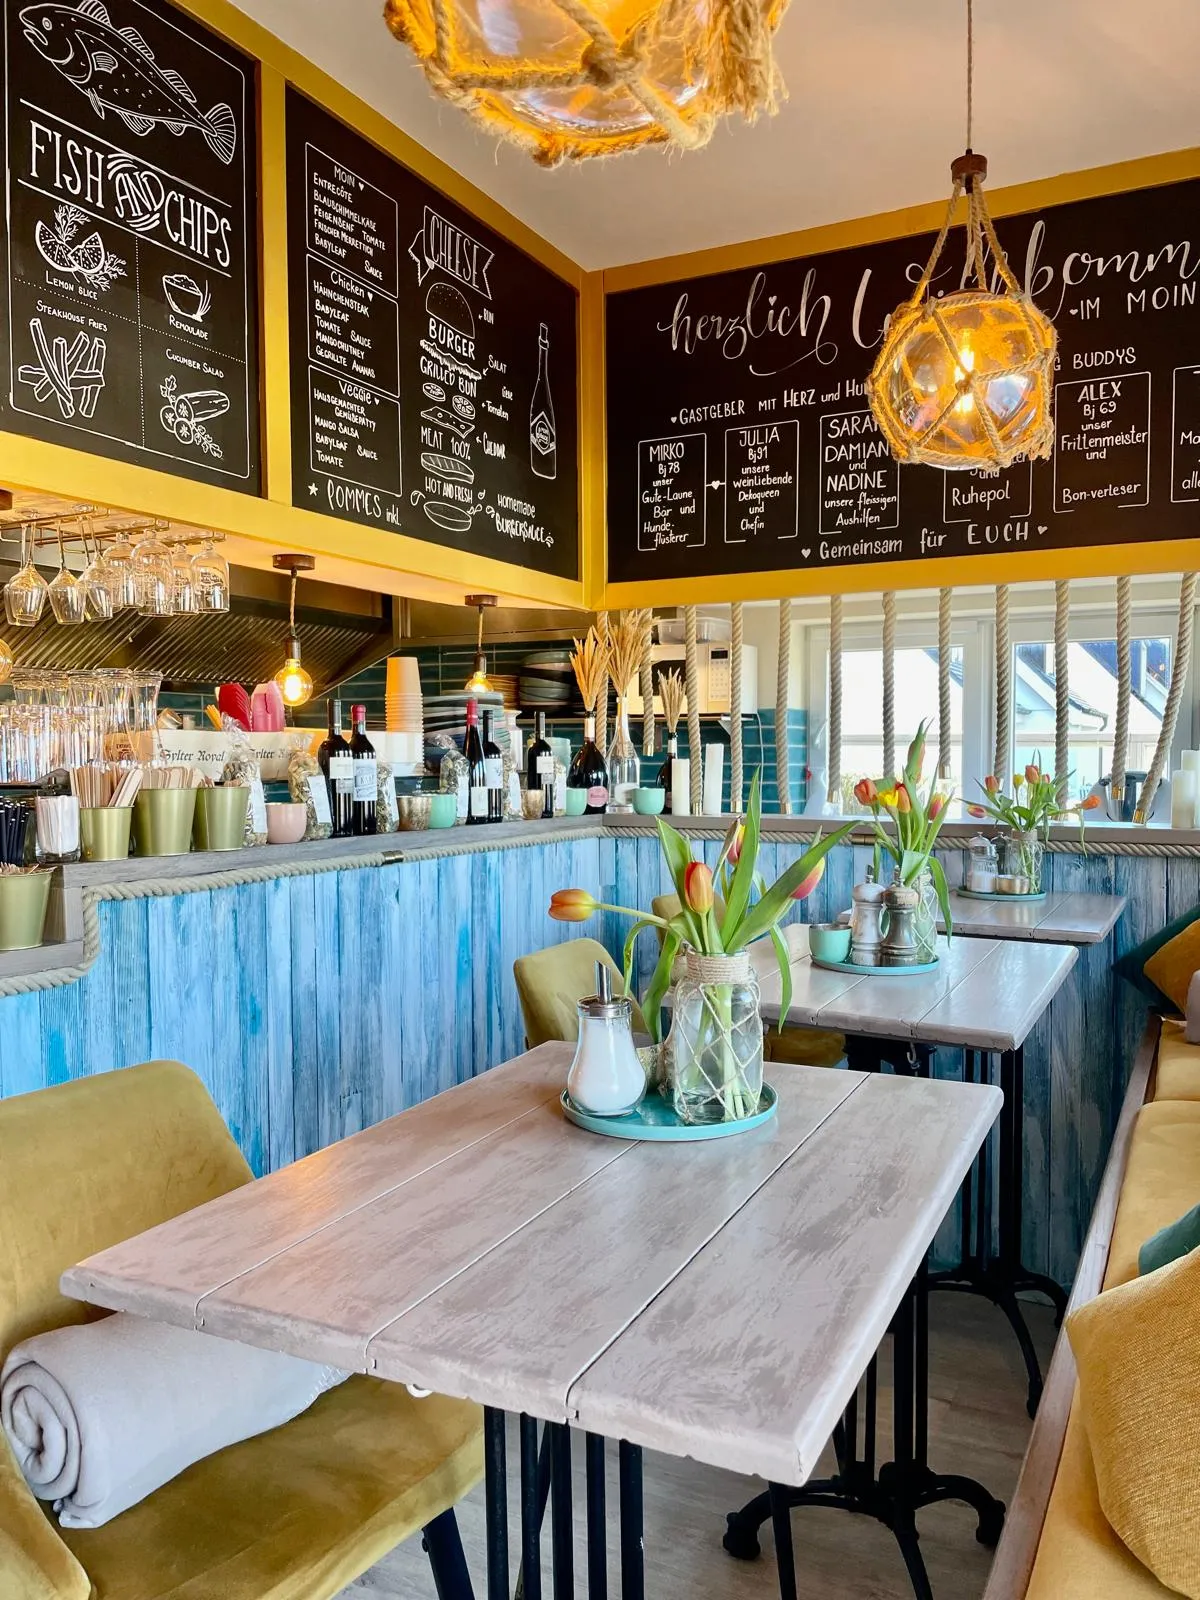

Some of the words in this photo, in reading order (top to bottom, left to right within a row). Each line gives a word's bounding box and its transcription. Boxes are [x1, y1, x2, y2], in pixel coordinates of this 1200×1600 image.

[314, 172, 352, 203] ENTRECÔTE
[334, 166, 355, 188] MOIN
[30, 120, 104, 208] FISH
[114, 171, 164, 218] AND
[164, 191, 232, 267] CHIPS
[314, 204, 354, 232] FEIGENSENF
[362, 230, 386, 250] TOMATE
[315, 233, 347, 258] BABYLEAF
[364, 260, 383, 280] SAUCE
[430, 216, 480, 288] CHEESE
[46, 270, 74, 291] LEMON
[78, 288, 98, 300] SLICE
[330, 271, 364, 298] Chicken
[314, 280, 370, 318] HÄHNCHENSTEAK
[316, 299, 350, 322] BABYLEAF
[1079, 297, 1100, 320] IM
[1128, 282, 1197, 313] MOIN
[36, 300, 84, 324] STEAKHOUSE
[484, 308, 494, 324] BUN
[656, 268, 838, 376] herzlich
[169, 314, 208, 340] REMOULADE
[315, 315, 341, 336] TOMATE
[350, 330, 372, 348] SAUCE
[429, 318, 475, 360] BURGER
[166, 349, 200, 370] CUCUMBER
[202, 363, 224, 378] SALAD
[316, 345, 348, 366] GEGRILLTE
[352, 360, 376, 378] ANANAS
[488, 354, 507, 374] SALAT
[1073, 346, 1136, 370] BUDDYS
[420, 356, 456, 386] GRILLED
[458, 376, 476, 398] BUN
[314, 388, 366, 416] HAUSGEMACHTER
[680, 400, 745, 424] GASTGEBER
[758, 398, 776, 412] MIT
[783, 389, 816, 408] HERZ
[821, 382, 840, 402] und
[1077, 381, 1122, 402] ALEX
[314, 415, 336, 430] MANGO
[338, 422, 359, 439] SALSA
[334, 406, 376, 432] GEMÜSEPATTY
[1081, 420, 1112, 431] unser
[316, 432, 348, 451] BABYLEAF
[356, 444, 378, 460] SAUCE
[421, 426, 443, 450] MEAT
[451, 436, 470, 460] 100%
[740, 426, 780, 446] JULIA
[1061, 425, 1148, 450] Frittenmeister
[316, 450, 344, 468] TOMATE
[650, 442, 684, 462] MIRKO
[825, 440, 889, 463] DAMIAN
[1086, 448, 1106, 460] und
[742, 464, 770, 474] unsere
[849, 458, 866, 470] und
[425, 476, 441, 494] HOT
[442, 482, 454, 498] AND
[454, 486, 472, 504] FRESH
[653, 478, 674, 486] unser
[826, 470, 887, 492] NADINE
[327, 479, 382, 518] POMMES
[642, 488, 692, 503] Gute-Laune
[738, 490, 780, 504] Dekoqueen
[825, 496, 853, 508] unsere
[857, 492, 896, 510] fleissigen
[952, 481, 1010, 510] Ruhepol
[1062, 484, 1141, 503] Bon-verleser
[680, 498, 696, 514] und
[749, 502, 764, 514] und
[836, 508, 880, 528] Aushilfen
[740, 516, 764, 535] Chefin
[654, 530, 689, 548] flüsterer
[820, 538, 902, 560] Gemeinsam
[920, 528, 947, 553] für
[968, 522, 1028, 545] EUCH
